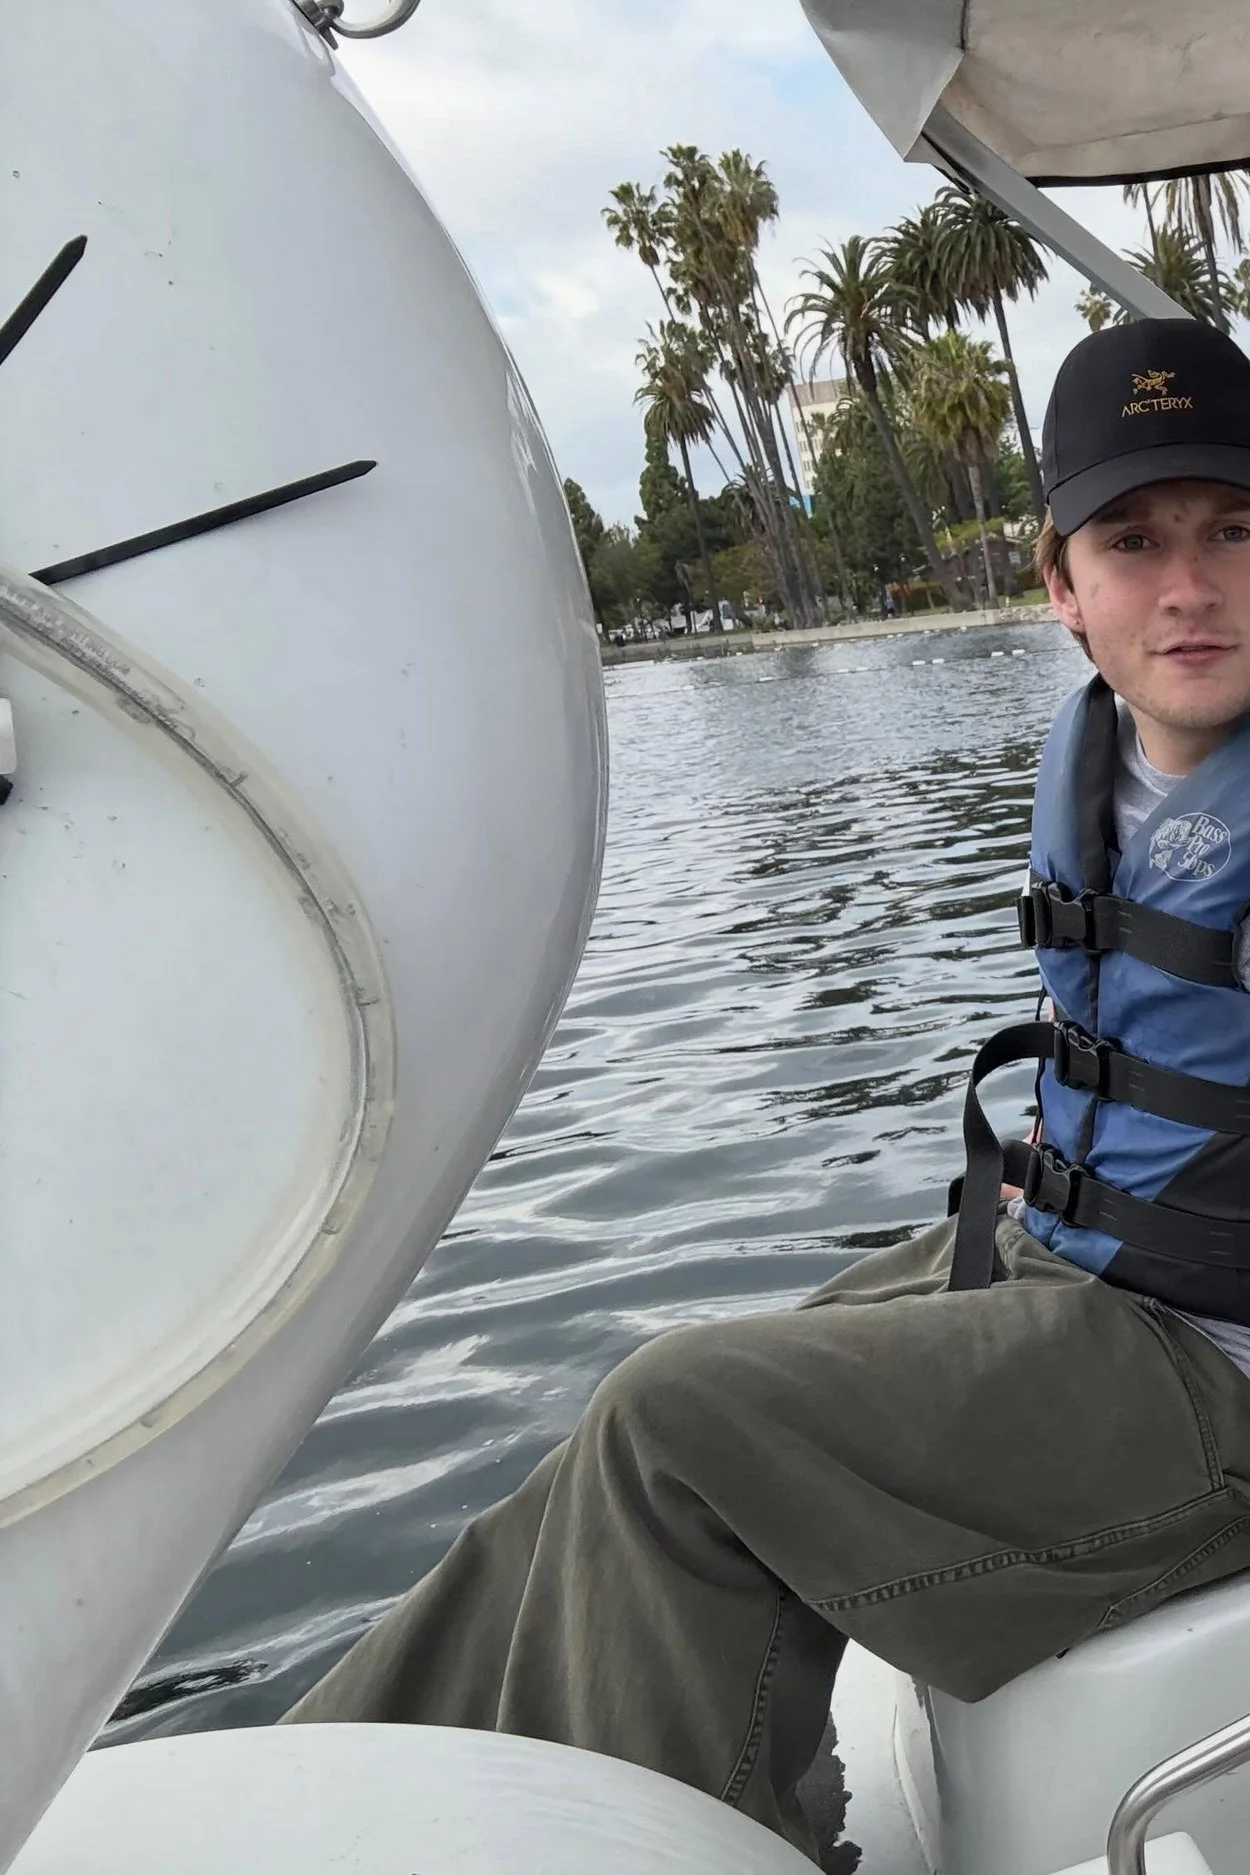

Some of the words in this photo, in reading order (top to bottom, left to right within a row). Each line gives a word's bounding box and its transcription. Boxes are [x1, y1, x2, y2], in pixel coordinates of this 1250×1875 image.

[1121, 396, 1193, 418] ARC'TERYX
[1192, 815, 1228, 844] Bass
[1187, 834, 1210, 856] Pro
[1177, 851, 1216, 877] Shops
